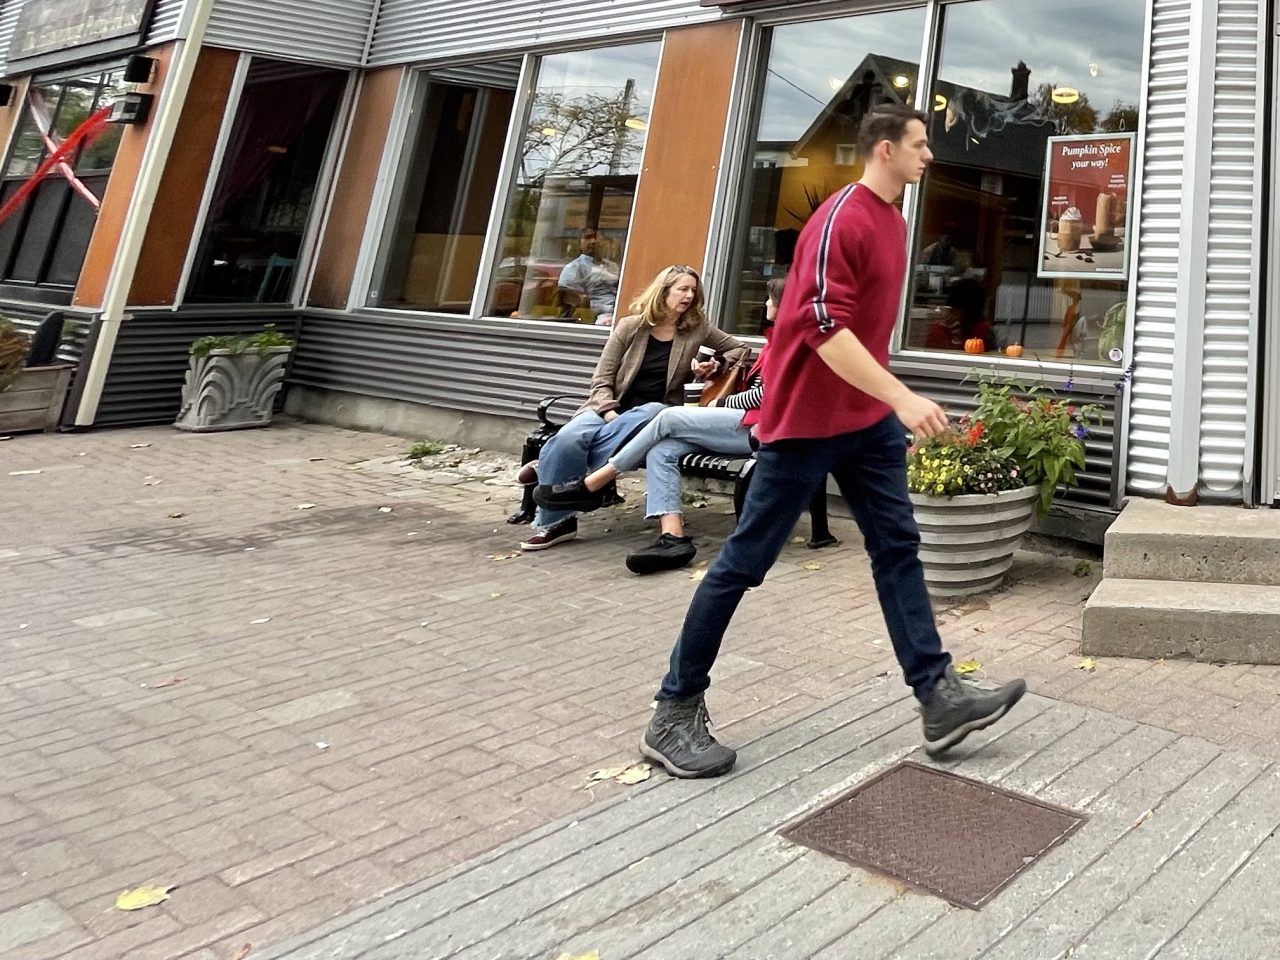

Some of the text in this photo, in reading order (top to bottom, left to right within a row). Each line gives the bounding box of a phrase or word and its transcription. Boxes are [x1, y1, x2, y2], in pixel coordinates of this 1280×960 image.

[1062, 143, 1121, 157] Pumpkin Spice
[1071, 158, 1109, 170] your way!
